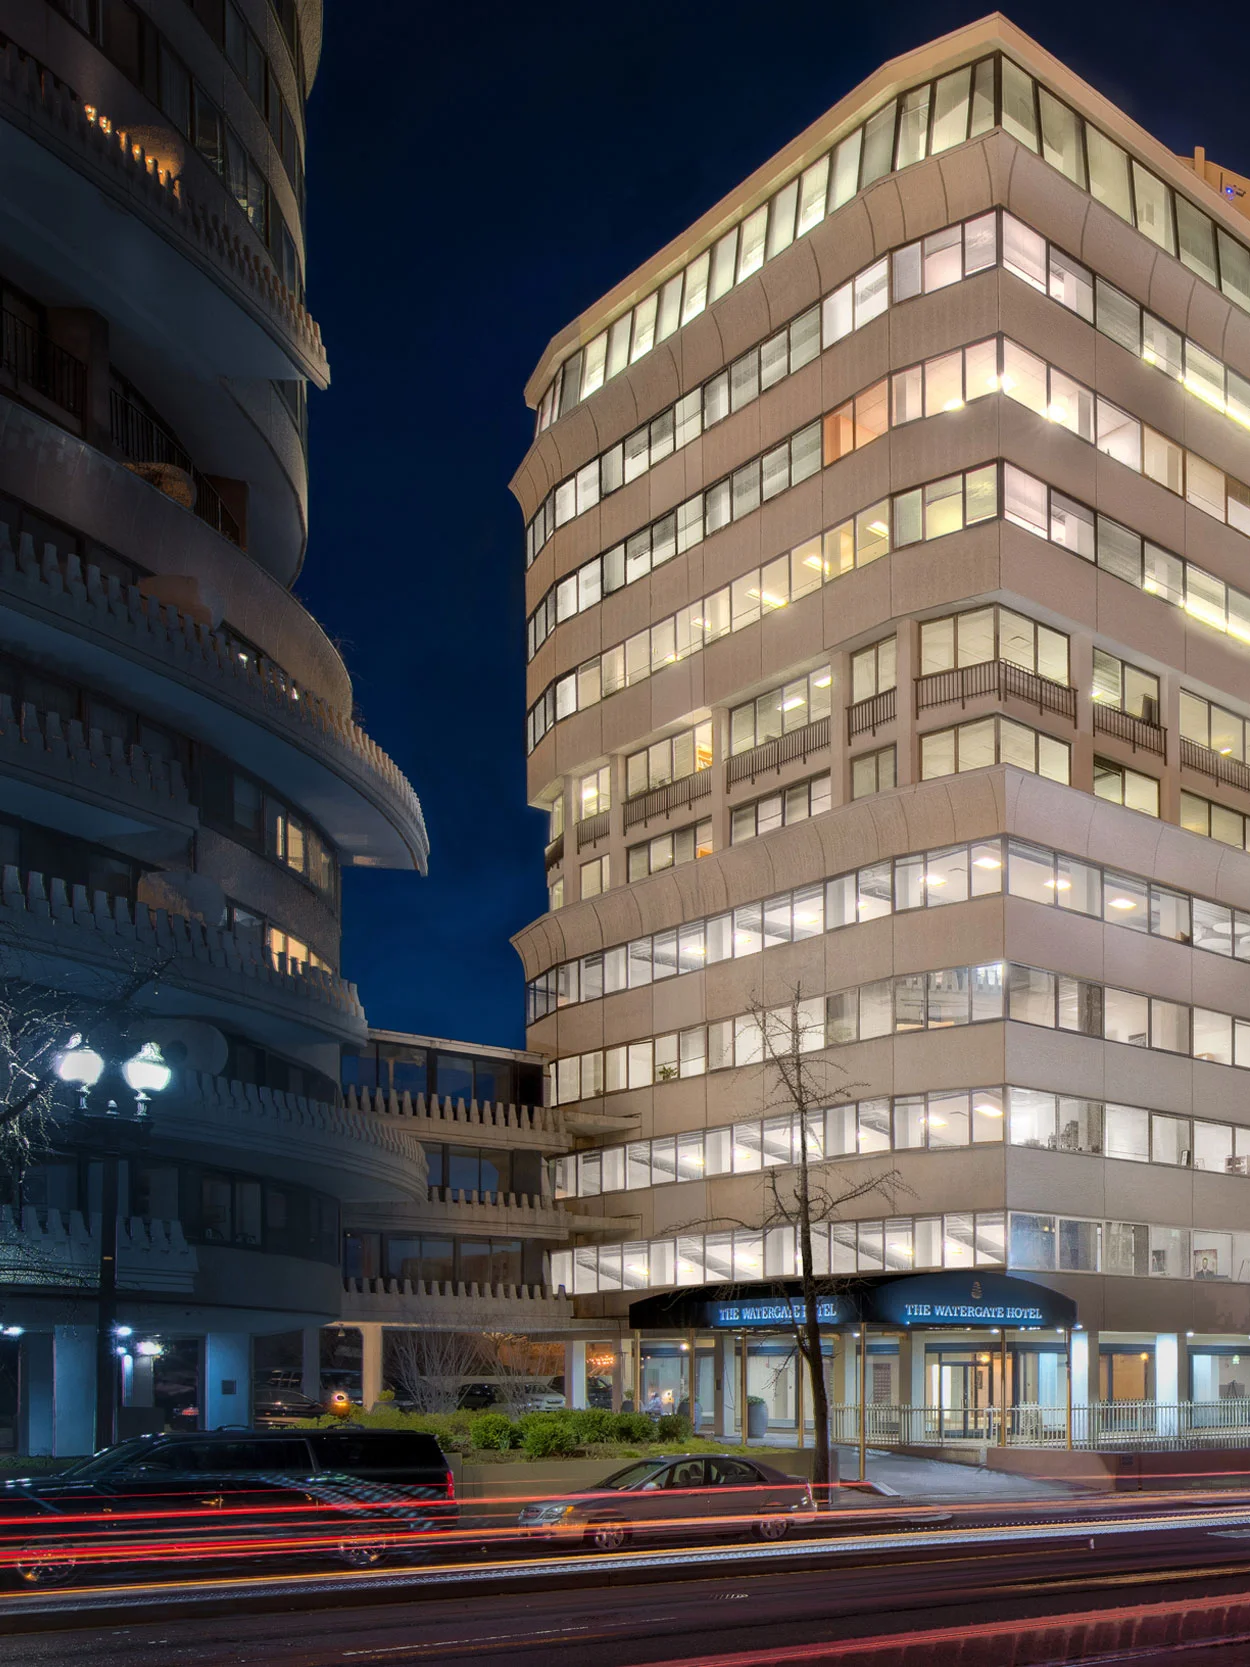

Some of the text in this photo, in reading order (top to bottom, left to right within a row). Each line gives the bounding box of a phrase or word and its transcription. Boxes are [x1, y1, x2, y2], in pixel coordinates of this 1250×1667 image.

[719, 1308, 740, 1320] THE
[905, 1304, 1043, 1319] THE WATERGATE HOTEL
